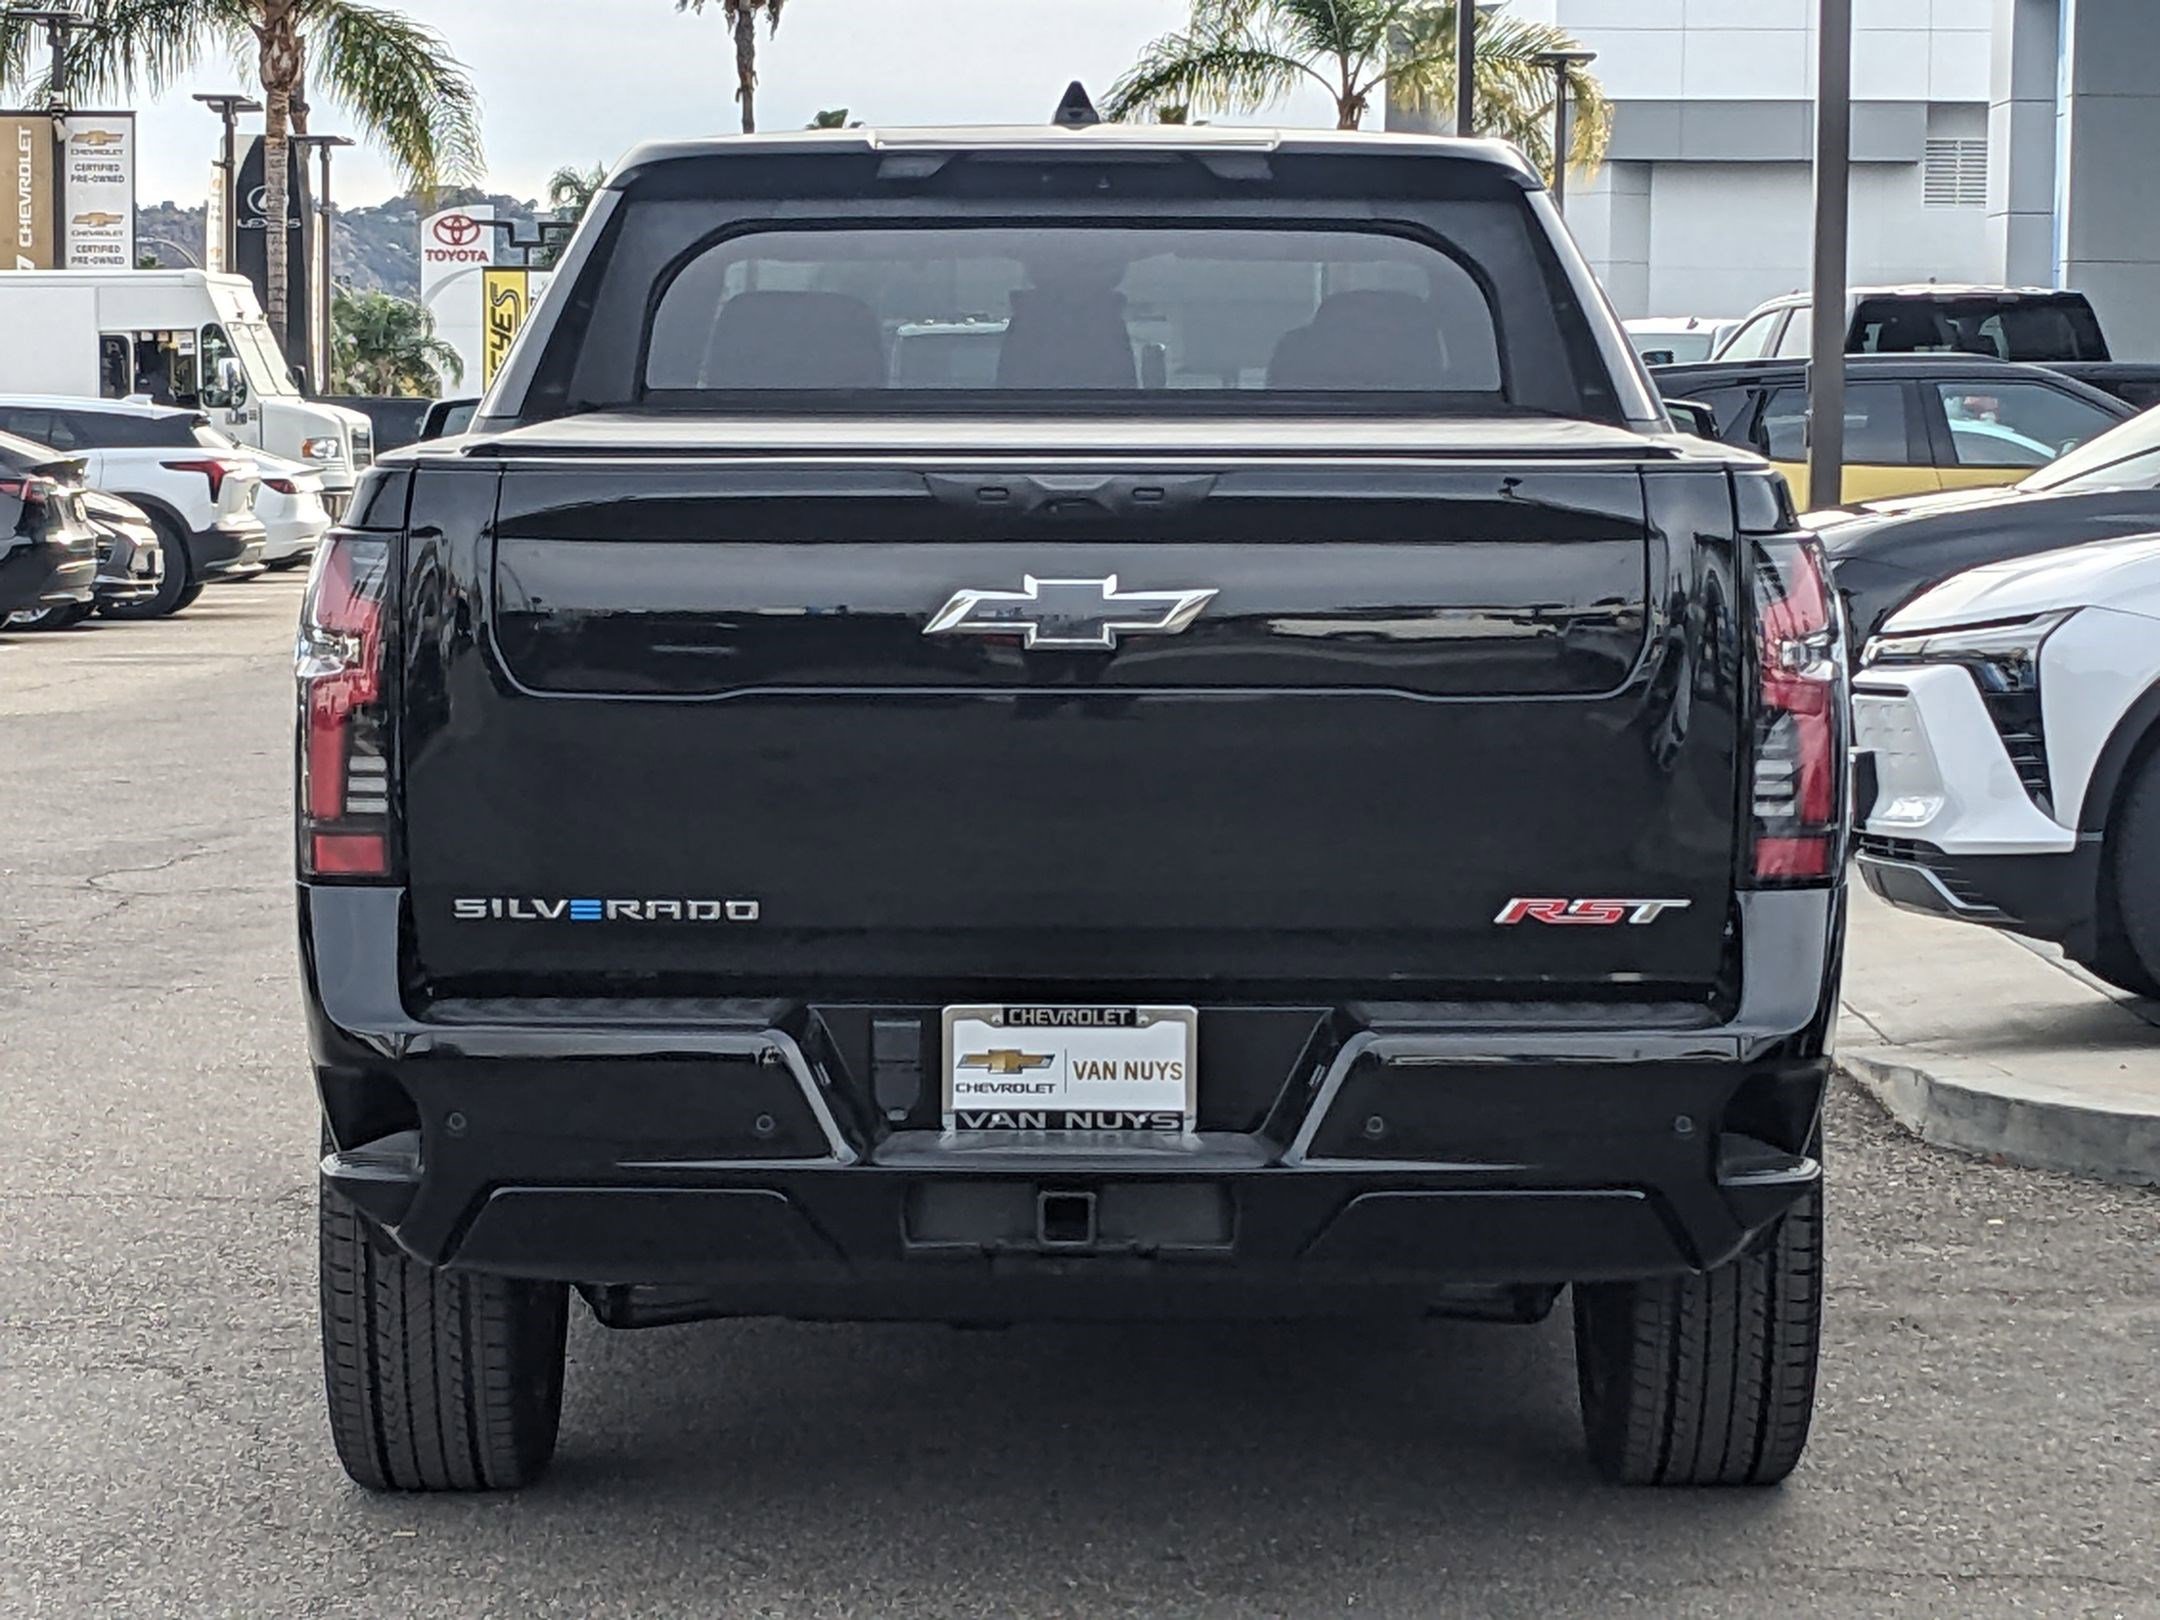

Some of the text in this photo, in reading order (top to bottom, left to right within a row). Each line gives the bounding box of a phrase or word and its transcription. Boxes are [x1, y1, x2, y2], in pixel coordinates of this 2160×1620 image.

[74, 163, 120, 171] CERTIFIED
[70, 174, 125, 183] PRE-OWNED
[18, 126, 32, 247] CHEVROLET
[75, 244, 121, 253] CERTIFIED
[425, 249, 489, 262] TOYOTA
[70, 256, 125, 265] PRE-OWNED
[453, 898, 760, 920] SILVERADO
[1494, 898, 1692, 924] RST
[1008, 1008, 1131, 1025] CHEVROLET
[1073, 1060, 1183, 1081] VAN NUYS
[955, 1082, 1057, 1094] CHEVROLET
[959, 1111, 1180, 1129] VAN NUYS
